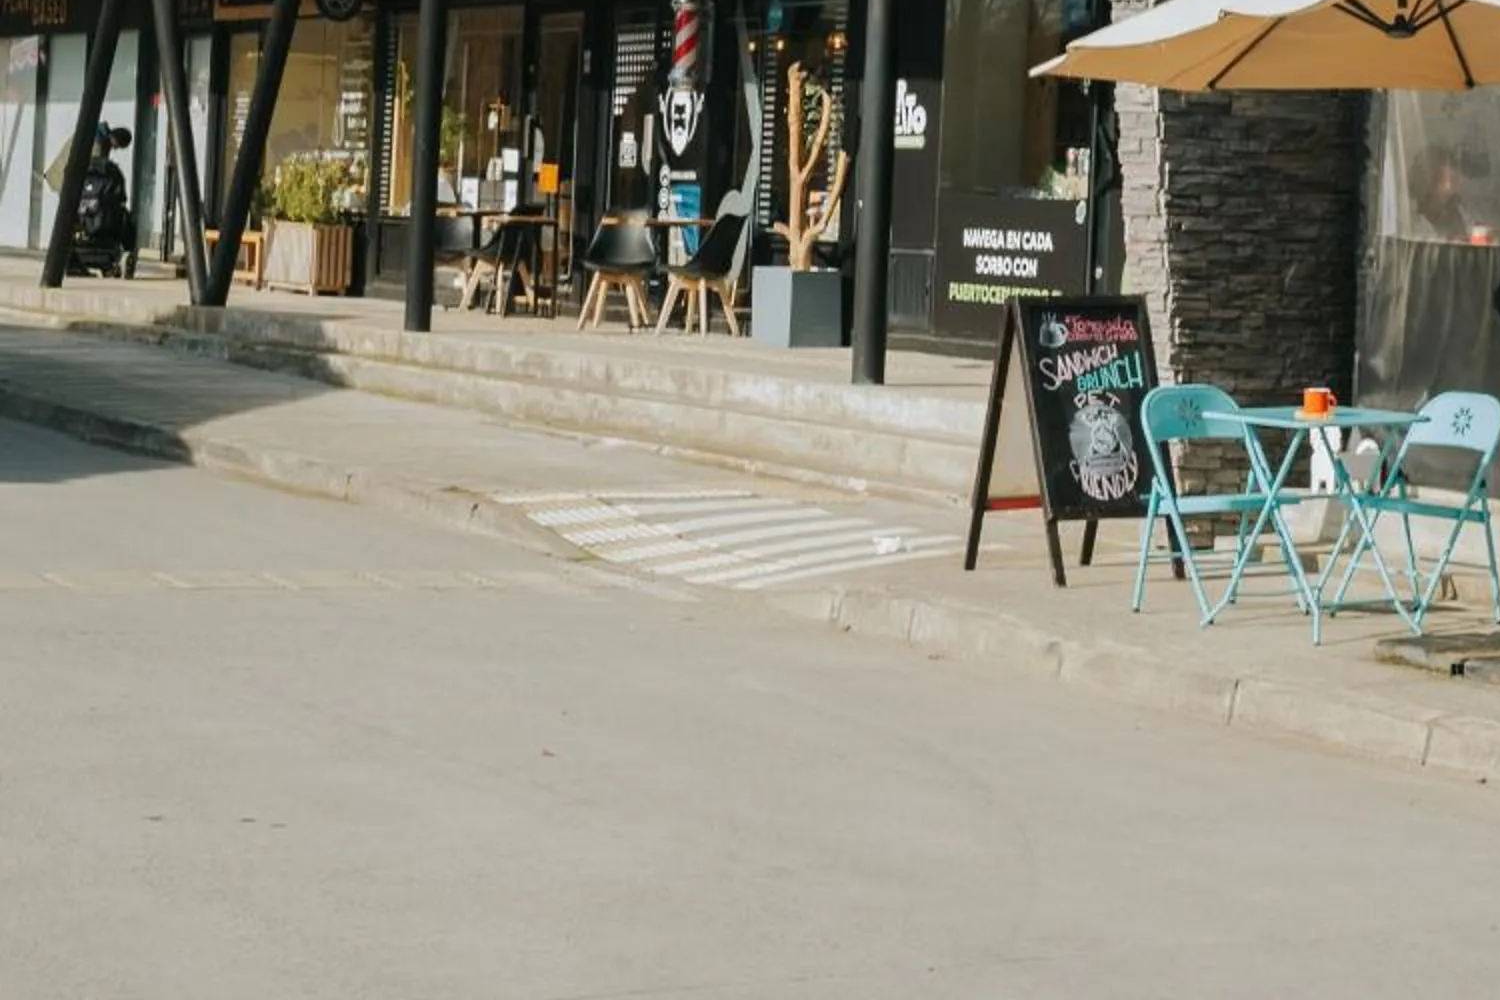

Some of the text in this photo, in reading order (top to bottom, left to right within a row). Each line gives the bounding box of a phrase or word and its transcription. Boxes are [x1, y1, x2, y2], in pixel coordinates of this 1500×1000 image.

[963, 227, 1054, 252] NAVEGA EN CADA
[975, 253, 1039, 278] SORBO CON
[1076, 349, 1144, 392] BRUNCH
